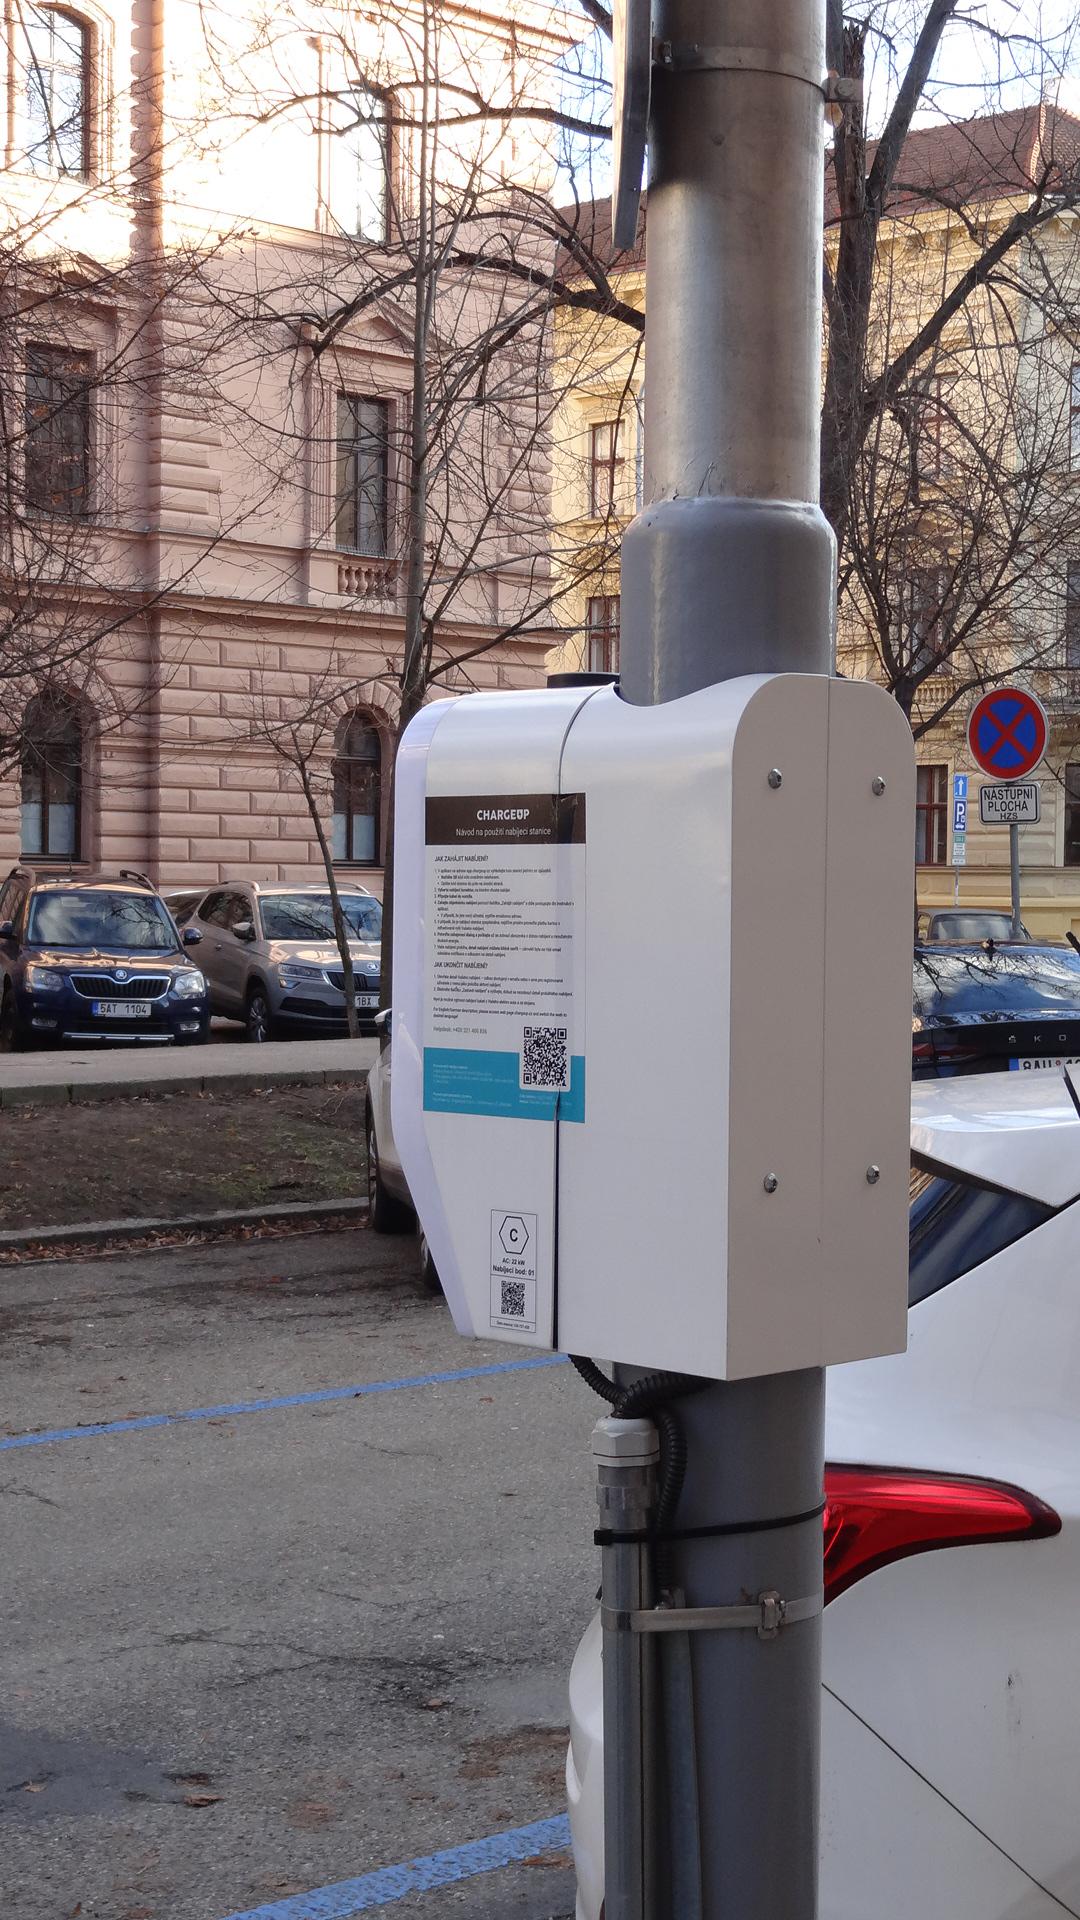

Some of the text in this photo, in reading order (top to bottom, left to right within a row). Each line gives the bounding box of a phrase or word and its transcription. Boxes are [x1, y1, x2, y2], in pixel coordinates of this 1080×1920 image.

[988, 801, 1028, 811] PLOCHA
[477, 808, 530, 820] CHARGEUP
[957, 803, 964, 822] P
[455, 827, 475, 837] Návod
[529, 827, 551, 836] stanice
[356, 997, 372, 1006] 1BX
[100, 1004, 147, 1014] 5AT 1104
[509, 1228, 518, 1242] C
